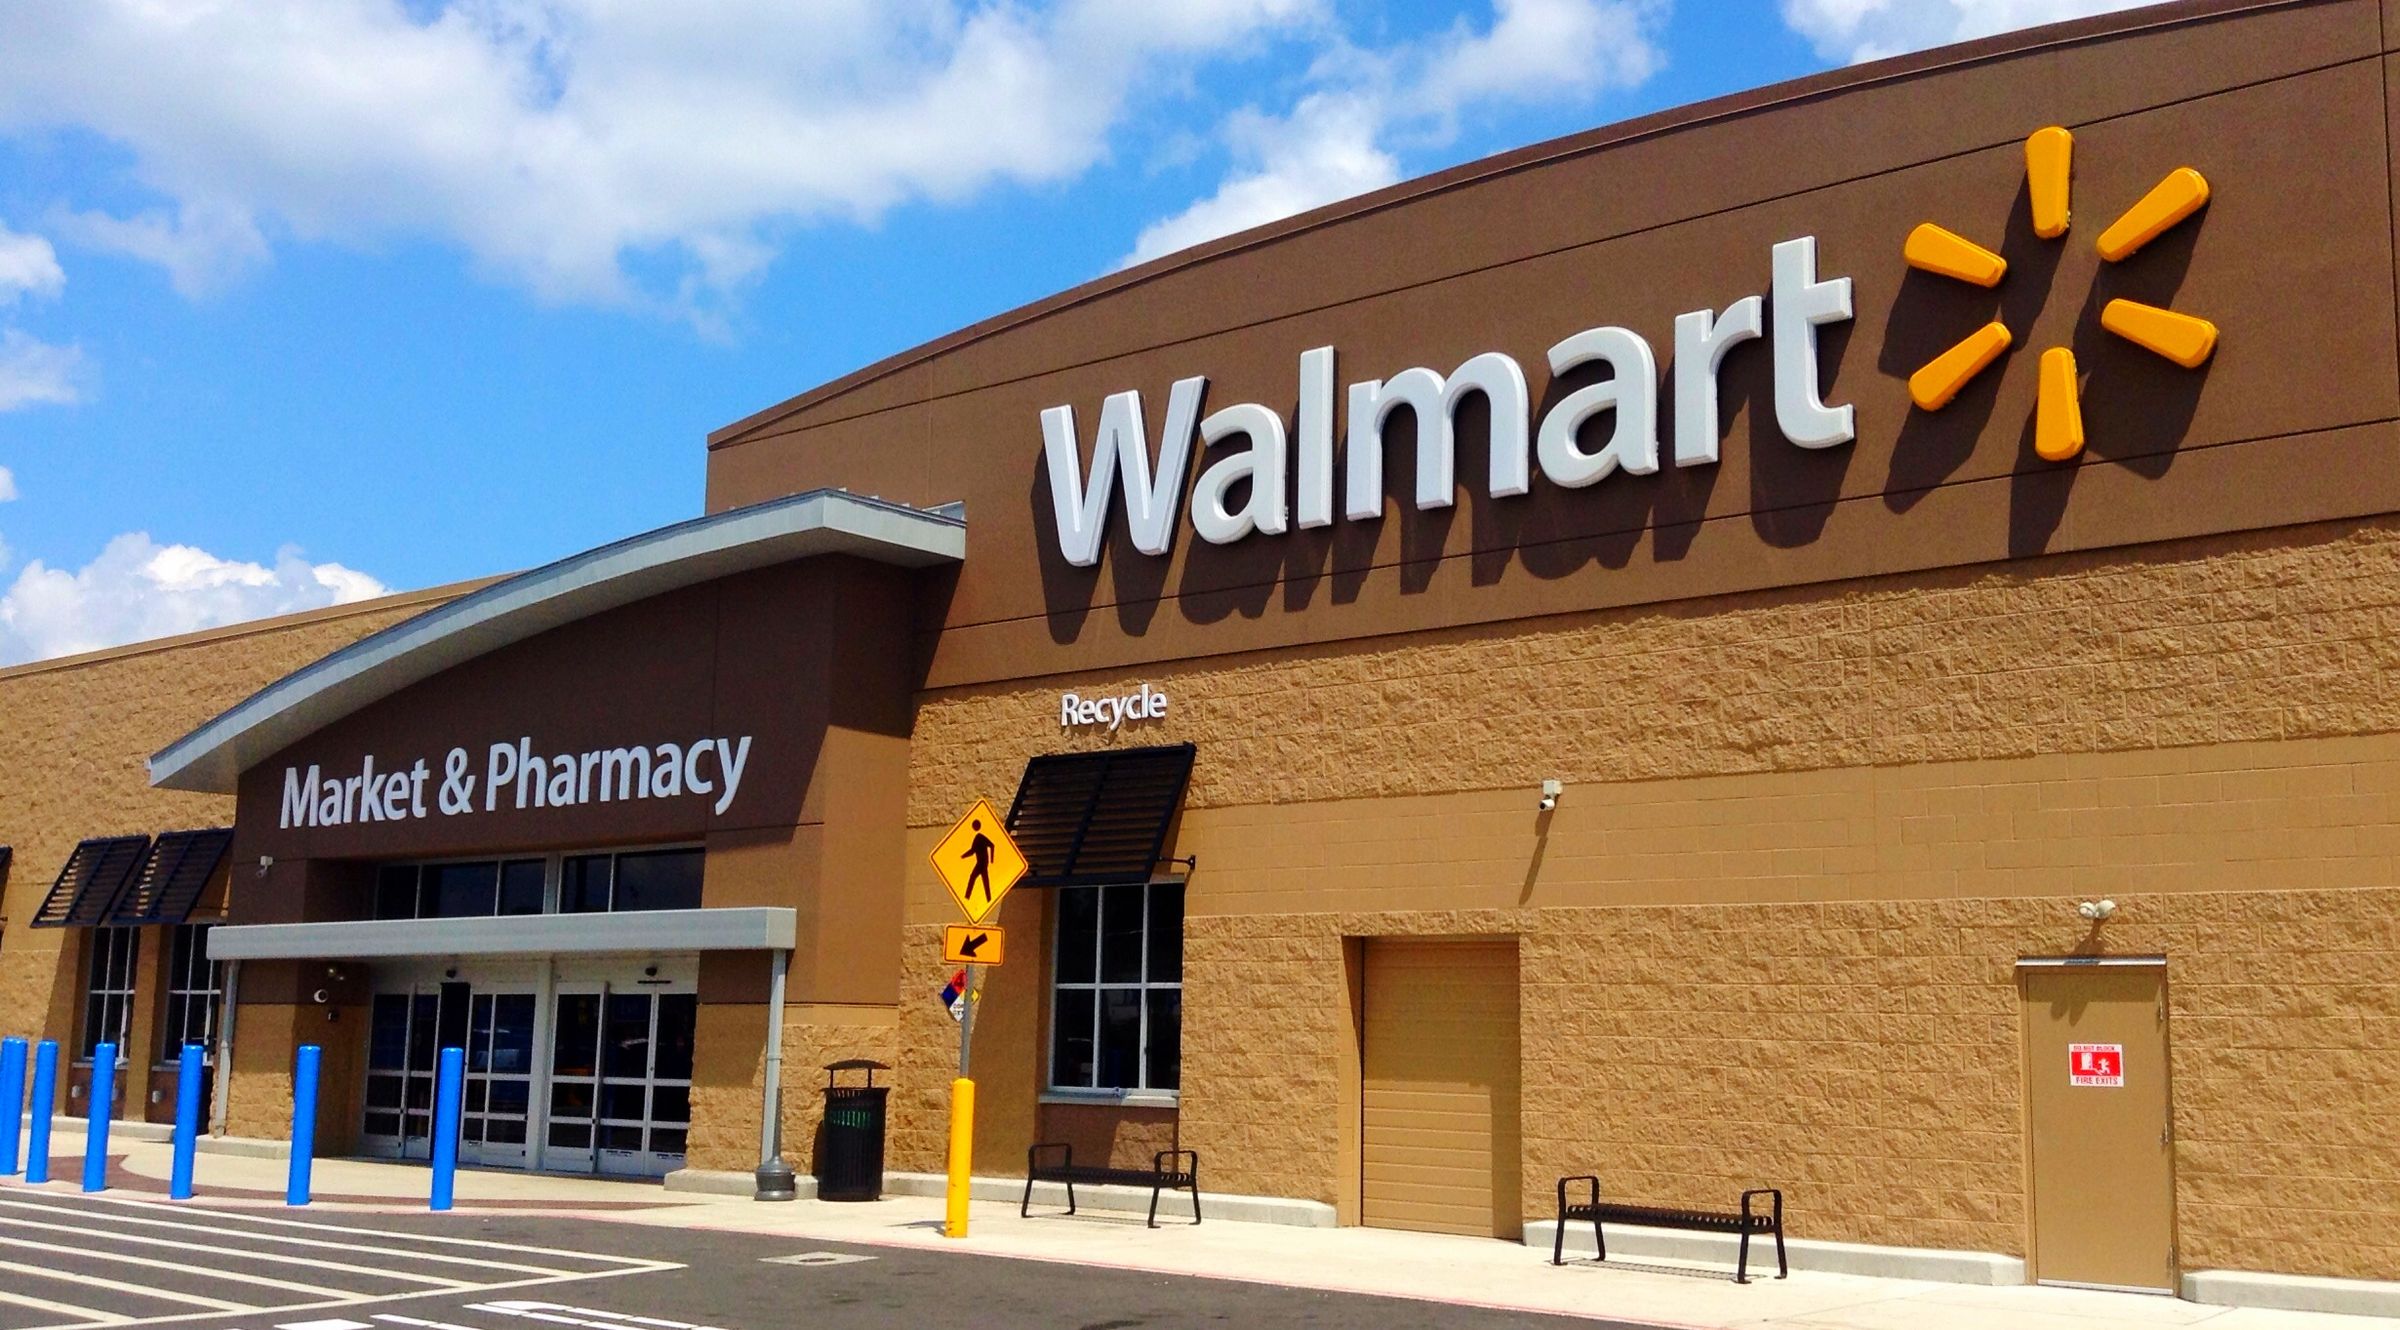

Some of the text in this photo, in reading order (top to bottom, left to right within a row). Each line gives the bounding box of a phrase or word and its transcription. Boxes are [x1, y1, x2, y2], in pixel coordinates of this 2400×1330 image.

[1039, 235, 1854, 567] Walmart
[1061, 683, 1168, 731] Recycle
[279, 735, 753, 829] Market & Pharmacy
[2075, 1076, 2118, 1085] FIRE EXITS
